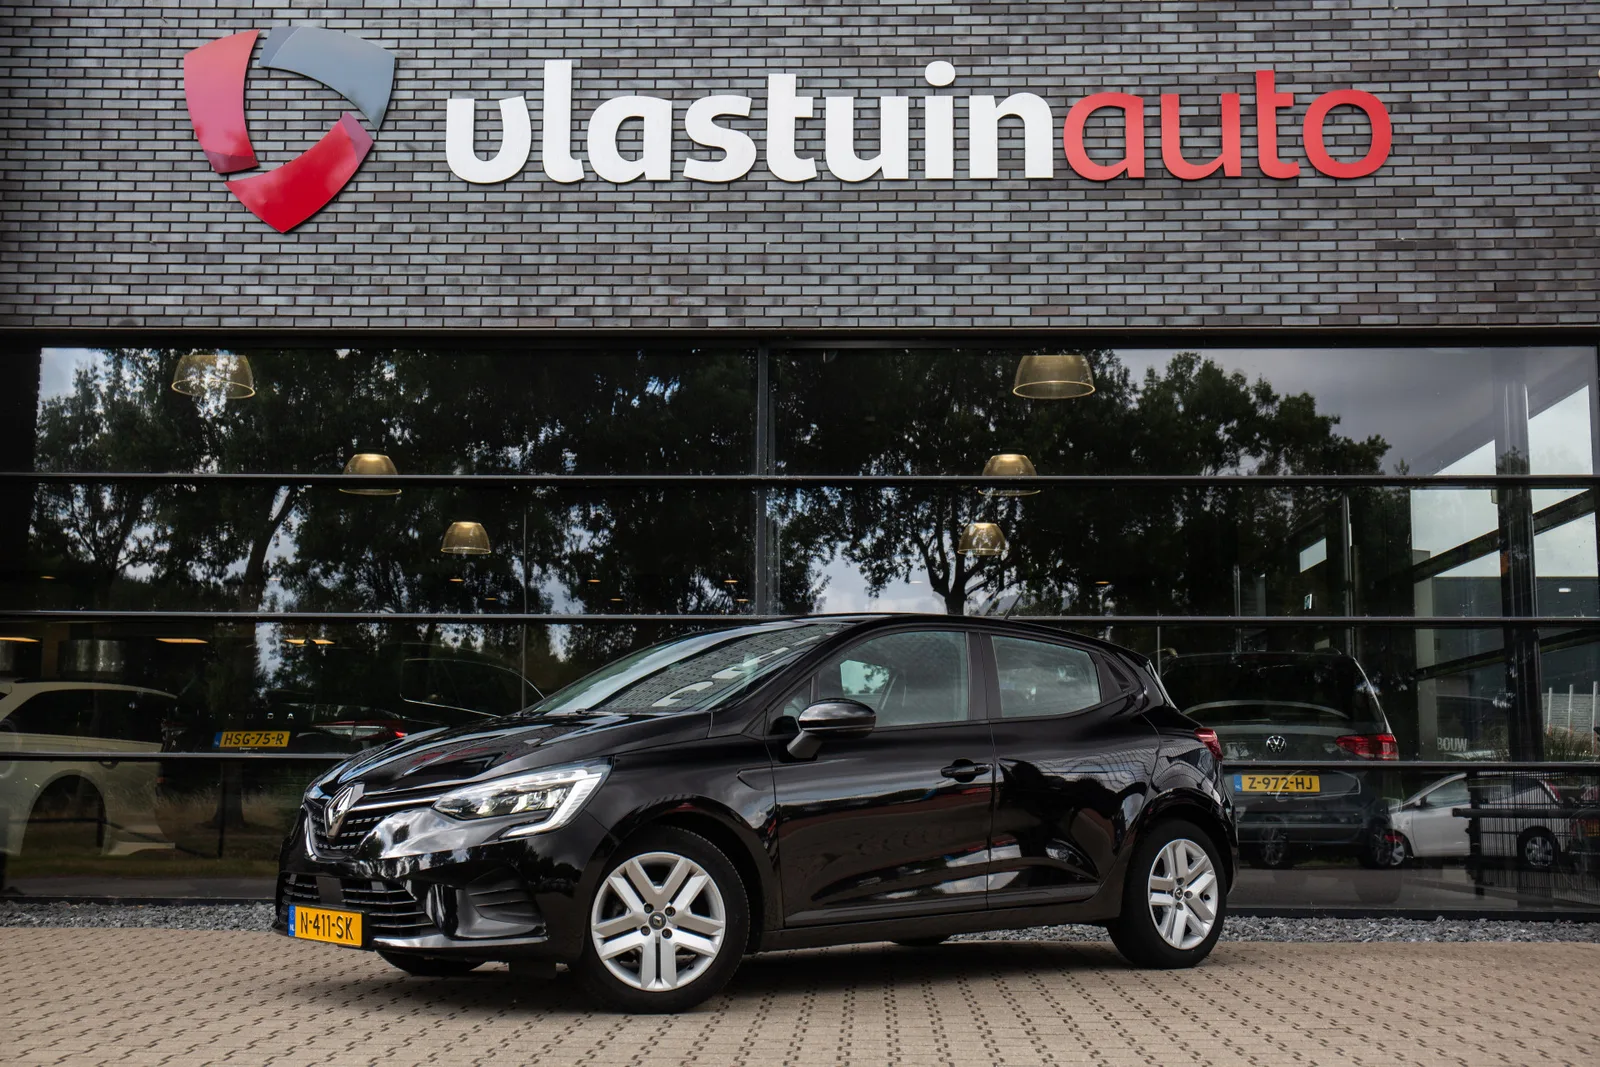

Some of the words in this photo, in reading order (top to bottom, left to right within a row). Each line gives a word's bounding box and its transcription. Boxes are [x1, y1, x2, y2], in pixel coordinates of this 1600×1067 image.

[223, 732, 285, 745] HSG-75-R
[1437, 737, 1468, 752] BOUW
[1248, 777, 1313, 790] Z-972-HJ
[301, 912, 354, 940] N-411-SK
